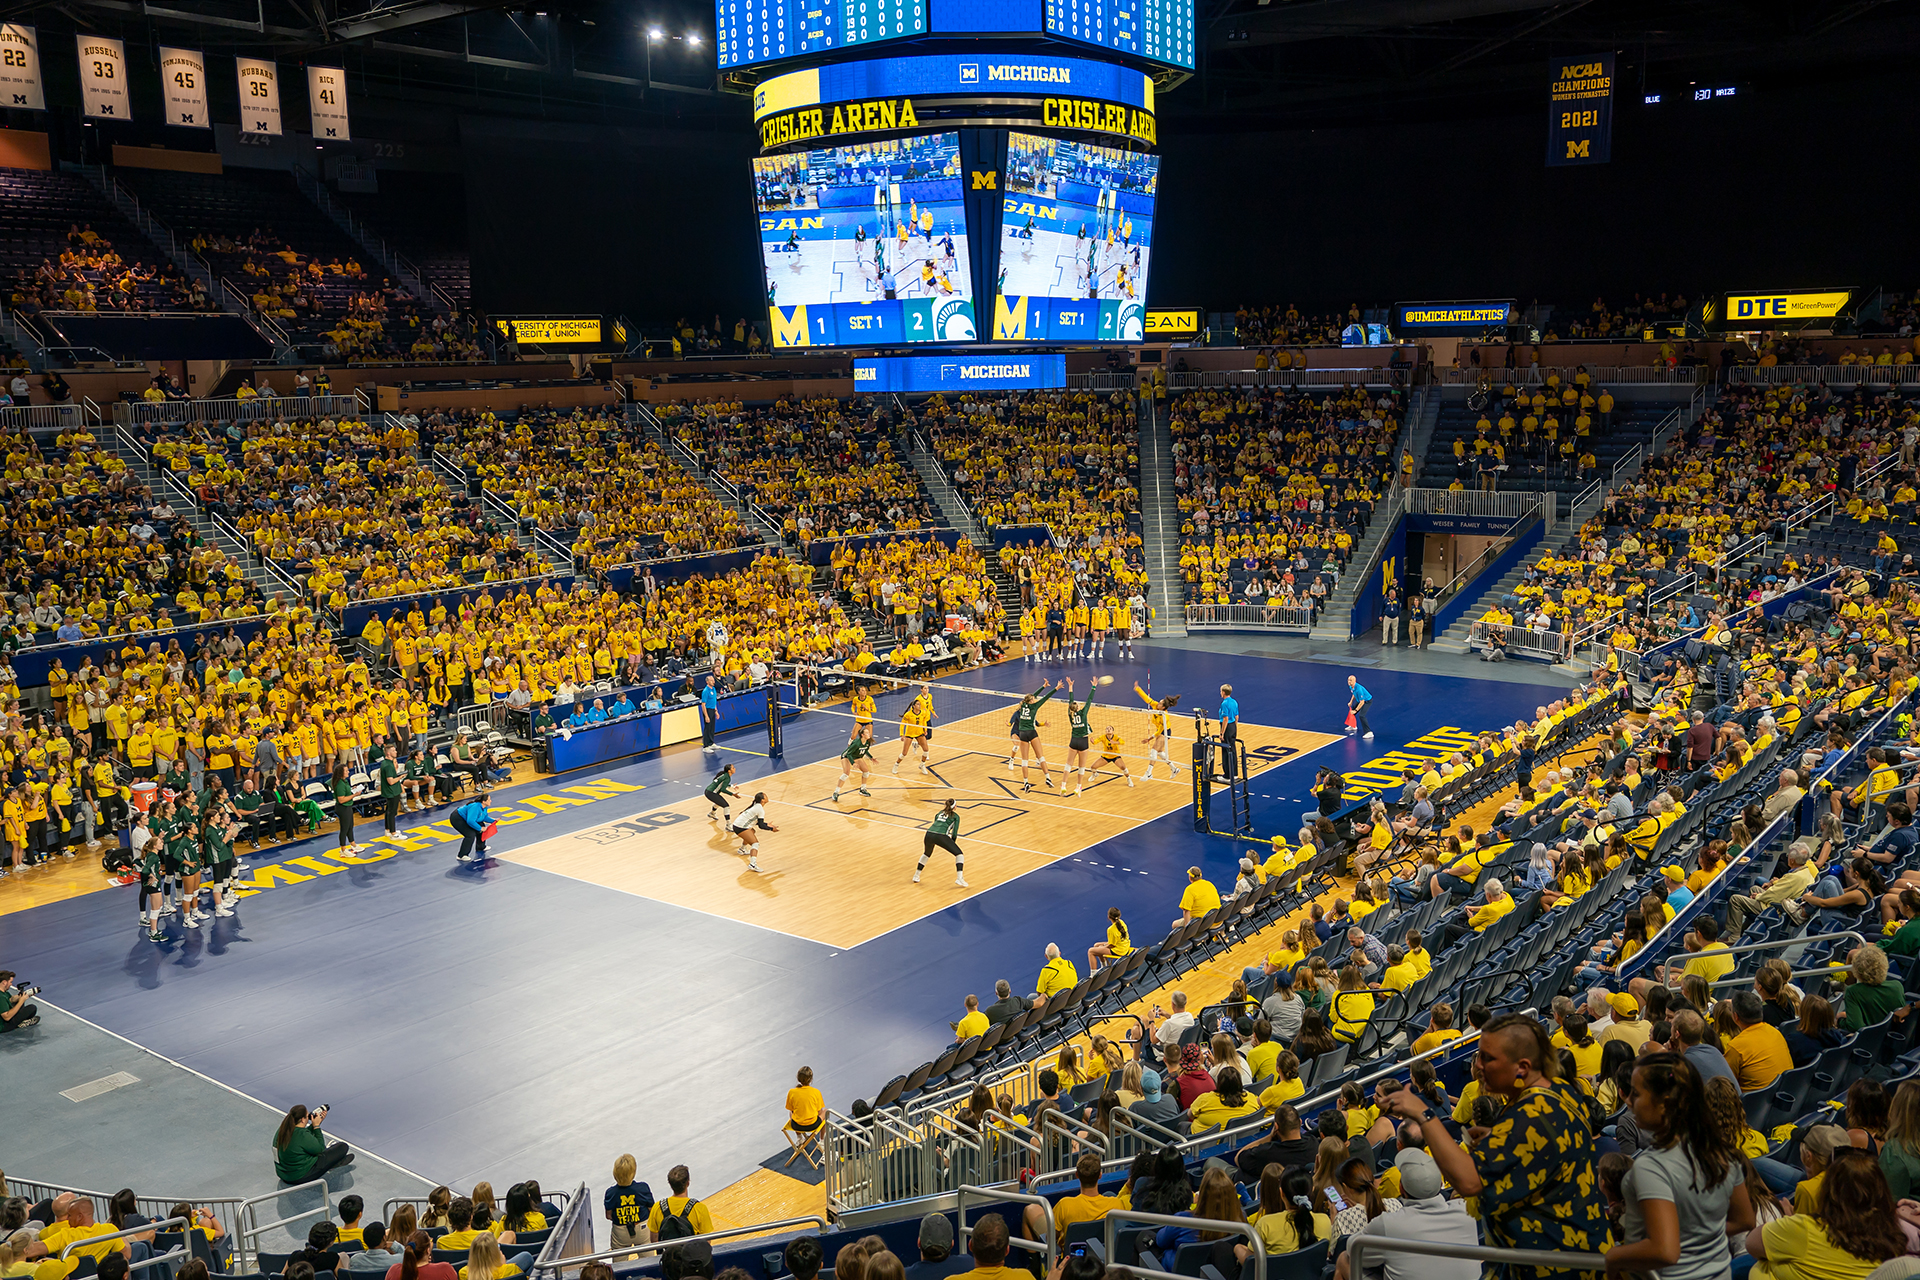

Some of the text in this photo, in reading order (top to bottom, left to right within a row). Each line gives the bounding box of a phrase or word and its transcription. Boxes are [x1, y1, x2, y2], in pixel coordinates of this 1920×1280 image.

[3, 48, 27, 68] 22
[84, 46, 119, 60] RUSSELL
[93, 61, 114, 79] 33
[162, 58, 203, 73] TOMJANOVICH
[1560, 62, 1603, 80] NCAA
[174, 71, 195, 89] 45
[241, 67, 274, 81] HUBBARD
[319, 76, 335, 85] RICE
[988, 65, 1071, 83] MICHIGAN
[250, 81, 268, 98] 35
[1552, 77, 1611, 93] CHAMPIONS
[12, 94, 27, 104] M
[319, 89, 335, 105] 41
[1576, 89, 1610, 99] GYMNASTICS
[1645, 95, 1661, 104] BLUE
[101, 104, 114, 115] M
[1043, 98, 1127, 134] CRISLER
[181, 113, 194, 123] M
[256, 121, 268, 131] M
[762, 99, 919, 147] CRISLER ARENA
[1561, 110, 1598, 129] 2021
[326, 128, 337, 137] M
[1566, 139, 1590, 159] M
[971, 171, 997, 190] M
[1738, 298, 1837, 317] DTE MIGreenPower
[817, 317, 825, 334] 1
[849, 315, 873, 330] SET
[876, 316, 883, 329] 1
[912, 312, 924, 330] 2
[1034, 310, 1041, 328] 1
[1059, 312, 1078, 326] SET
[1080, 313, 1085, 326] 1
[1104, 312, 1112, 329] 2
[1405, 309, 1504, 323] @UMICHATHLETICS
[960, 365, 1030, 379] MICHIGAN
[1433, 520, 1511, 530] WEISER FAMILY TUNNEL
[1022, 707, 1031, 716] 12
[1195, 765, 1203, 818] MICHIGAN
[573, 811, 691, 845] BIG
[620, 1194, 636, 1206] M
[616, 1206, 641, 1217] EVENT
